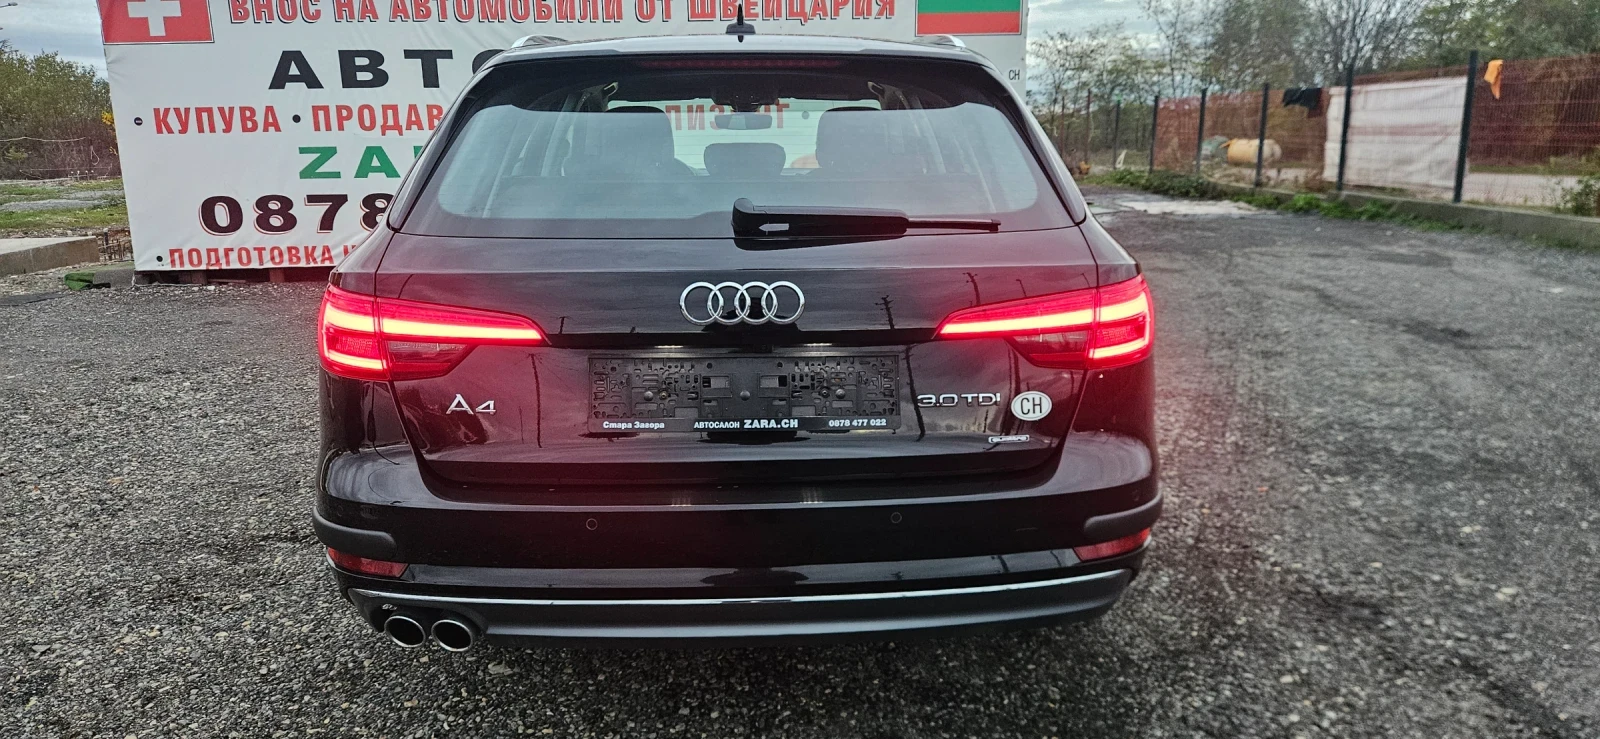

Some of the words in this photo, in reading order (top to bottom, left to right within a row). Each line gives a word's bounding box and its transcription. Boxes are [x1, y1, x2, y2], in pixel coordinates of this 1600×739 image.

[228, 0, 321, 23] ВНОС
[335, 0, 379, 22] НА
[389, 0, 623, 23] АВТОМОБИЛИ
[635, 0, 672, 22] ОТ
[1008, 69, 1021, 80] CH
[153, 105, 282, 134] КУПУВА
[298, 145, 423, 179] ZA
[169, 245, 334, 270] ПОДГОТОВКА
[445, 393, 497, 415] A4
[917, 393, 959, 408] 3.0
[960, 392, 1001, 407] TDI
[1020, 397, 1044, 416] CH
[602, 420, 633, 430] Стара
[633, 420, 665, 429] Загора
[693, 421, 740, 429] АВТОСАЛОН
[743, 419, 799, 429] ZARA.CH
[828, 419, 851, 427] 0878
[852, 419, 868, 427] 477
[869, 418, 887, 426] 022
